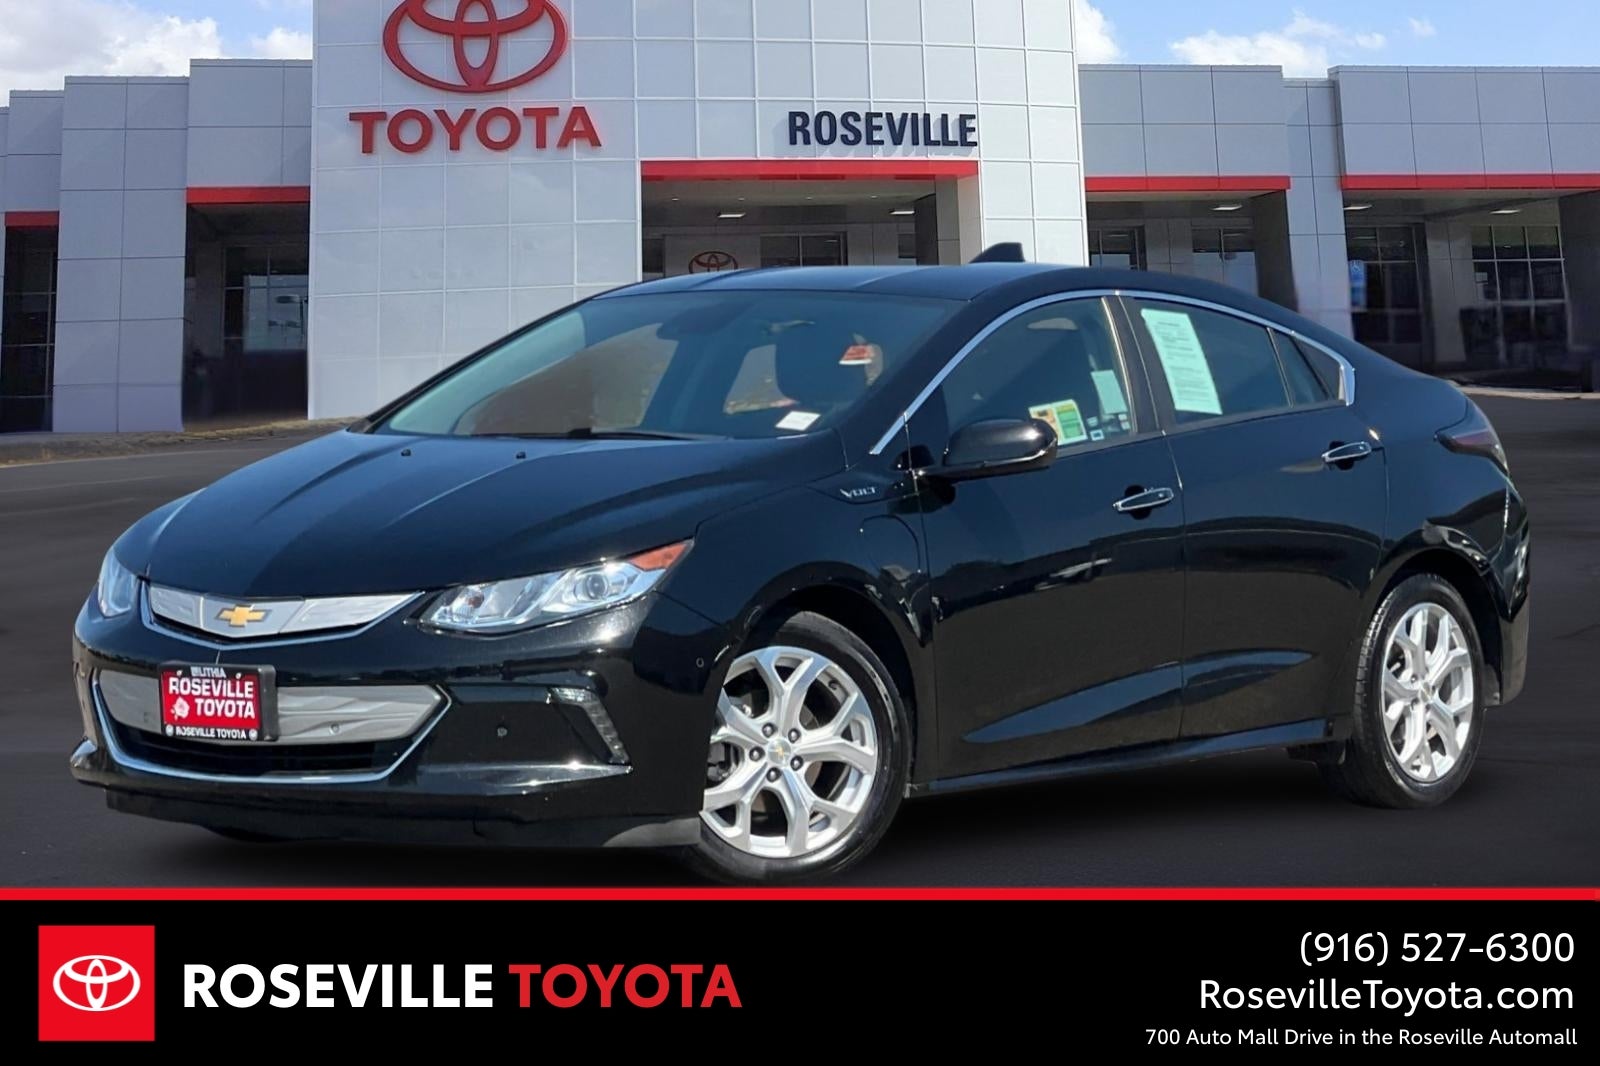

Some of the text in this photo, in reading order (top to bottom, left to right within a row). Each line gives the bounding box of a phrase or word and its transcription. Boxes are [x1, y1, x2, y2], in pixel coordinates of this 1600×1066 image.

[349, 107, 602, 154] TOYOTA
[788, 111, 978, 147] ROSEVILLE
[200, 666, 226, 678] LITHIA
[169, 677, 254, 698] ROSEVILLE
[195, 698, 256, 719] TOYOTA
[176, 725, 247, 739] ROSEVILLE TOYOTA
